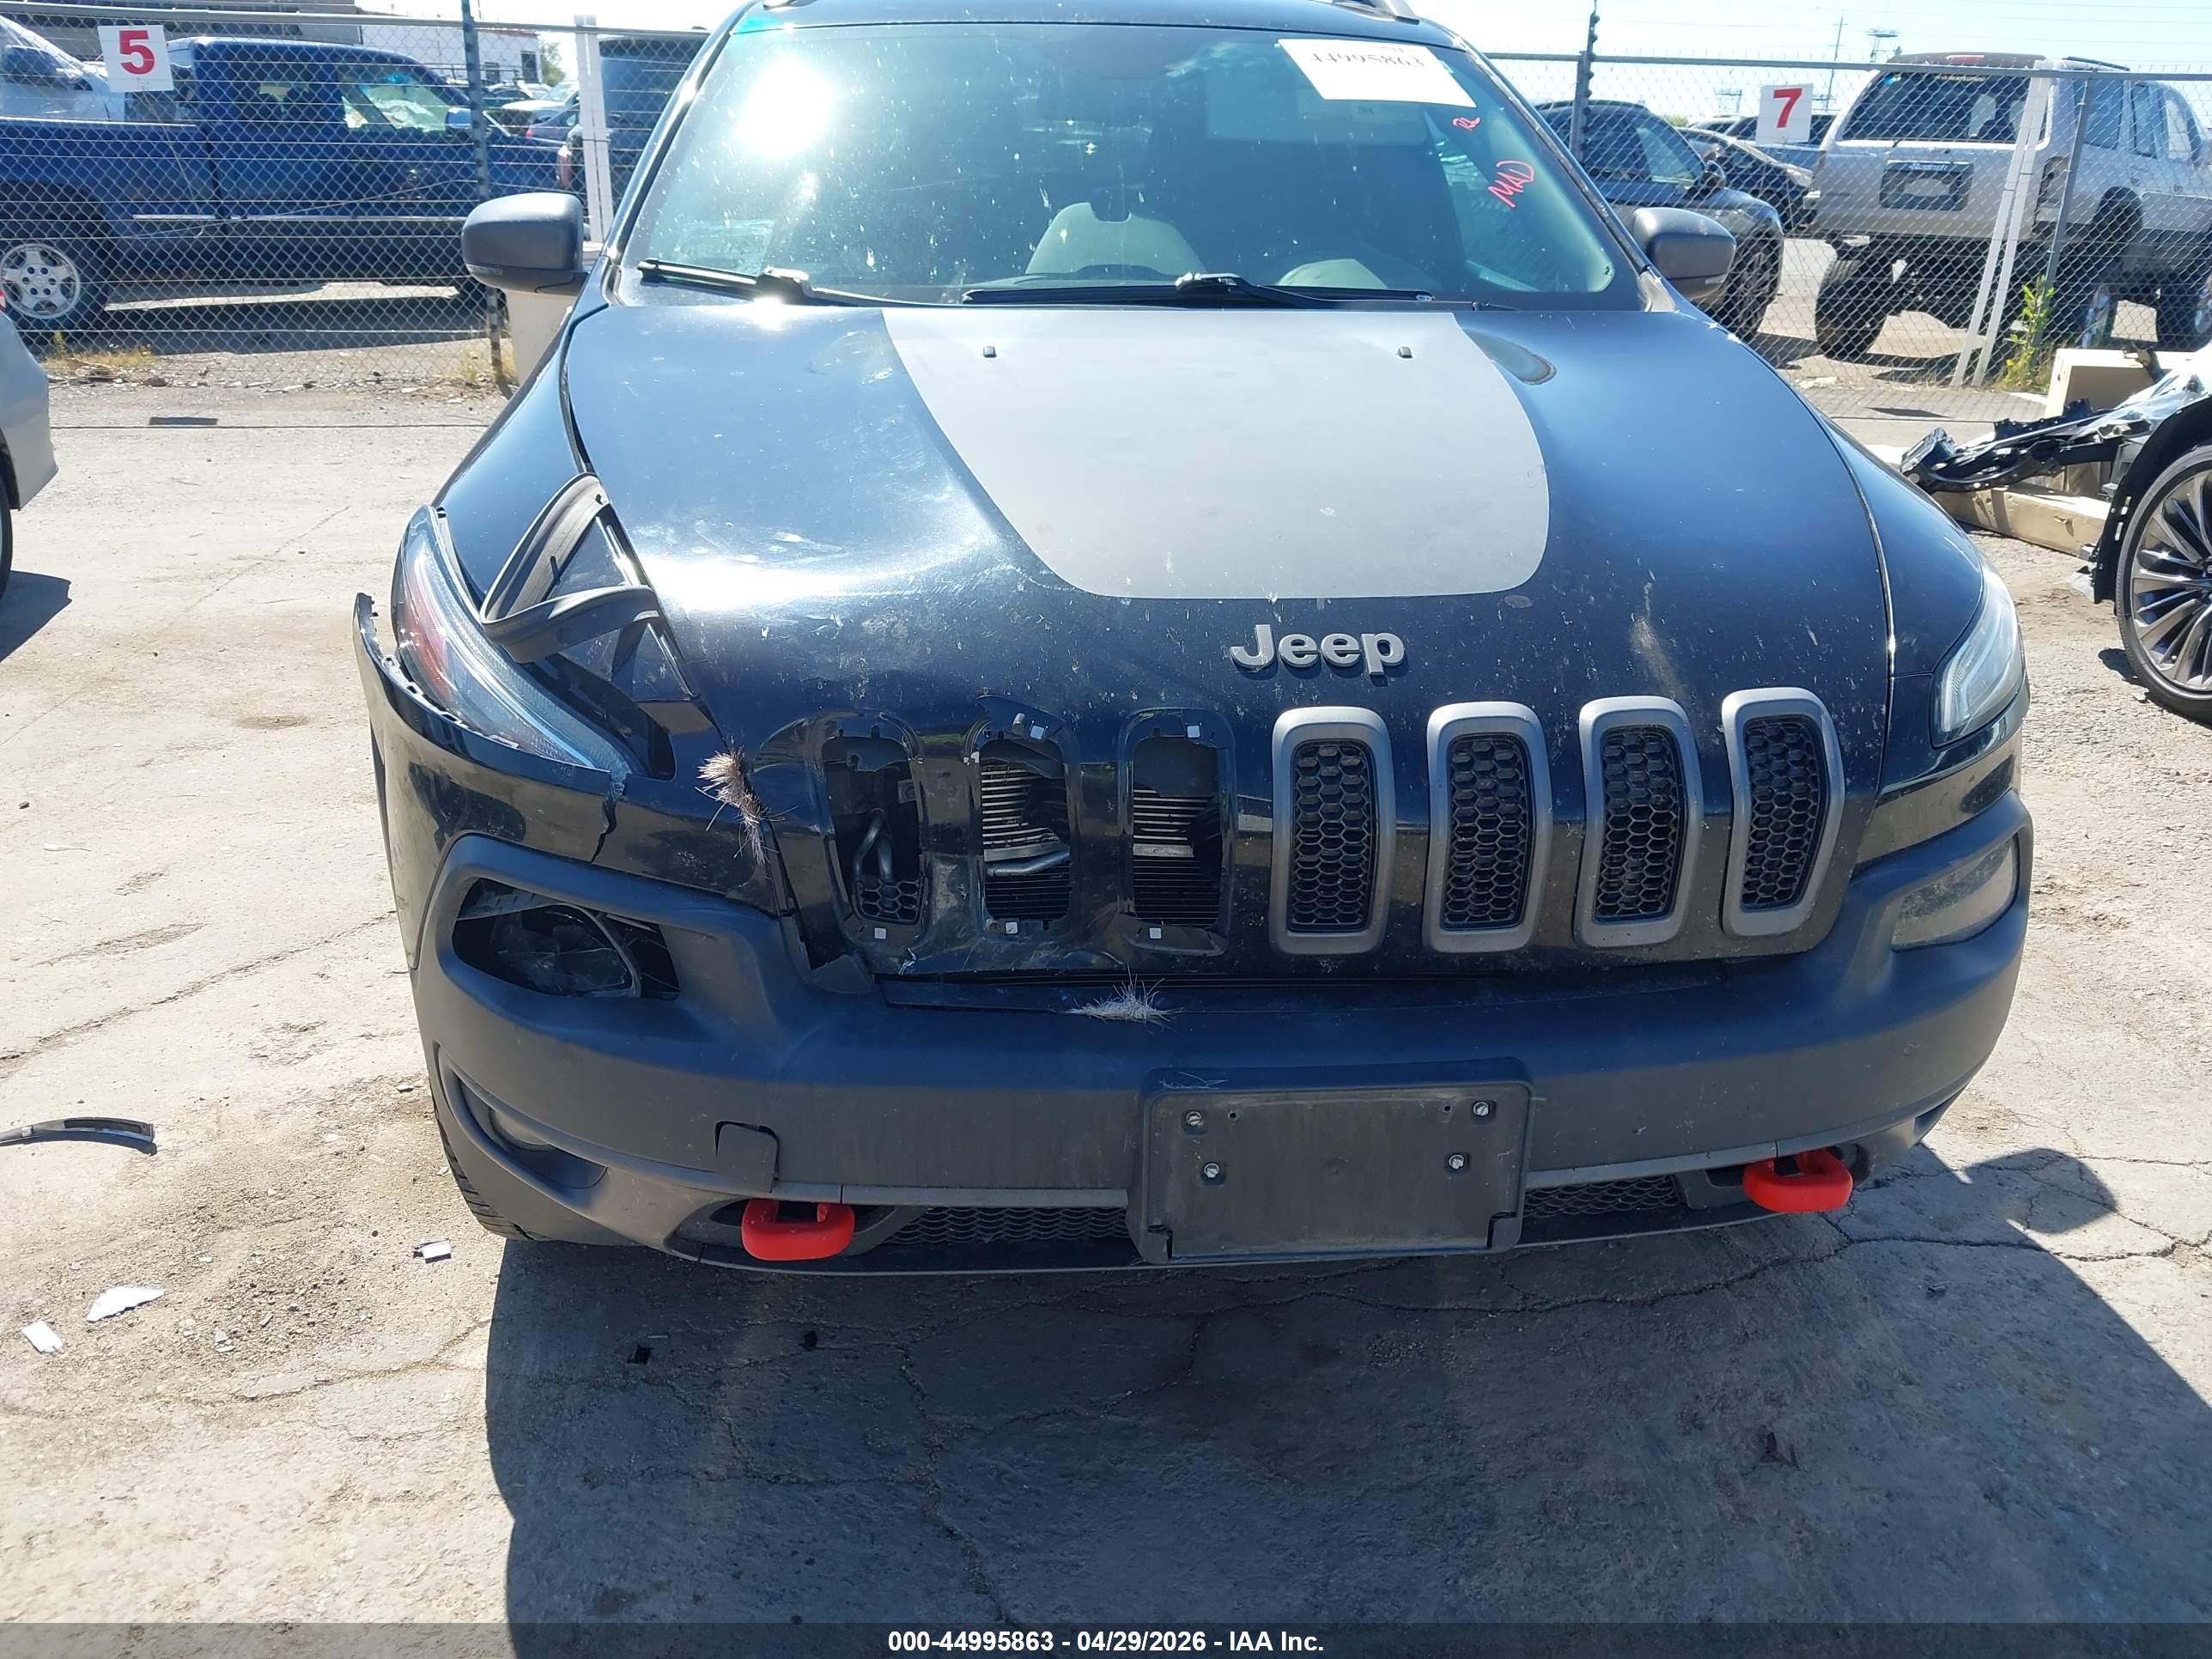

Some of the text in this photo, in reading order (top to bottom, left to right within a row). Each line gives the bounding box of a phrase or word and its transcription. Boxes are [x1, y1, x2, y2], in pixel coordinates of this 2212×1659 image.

[118, 30, 155, 75] 5
[1773, 88, 1802, 128] 7
[1231, 624, 1406, 676] Jeep
